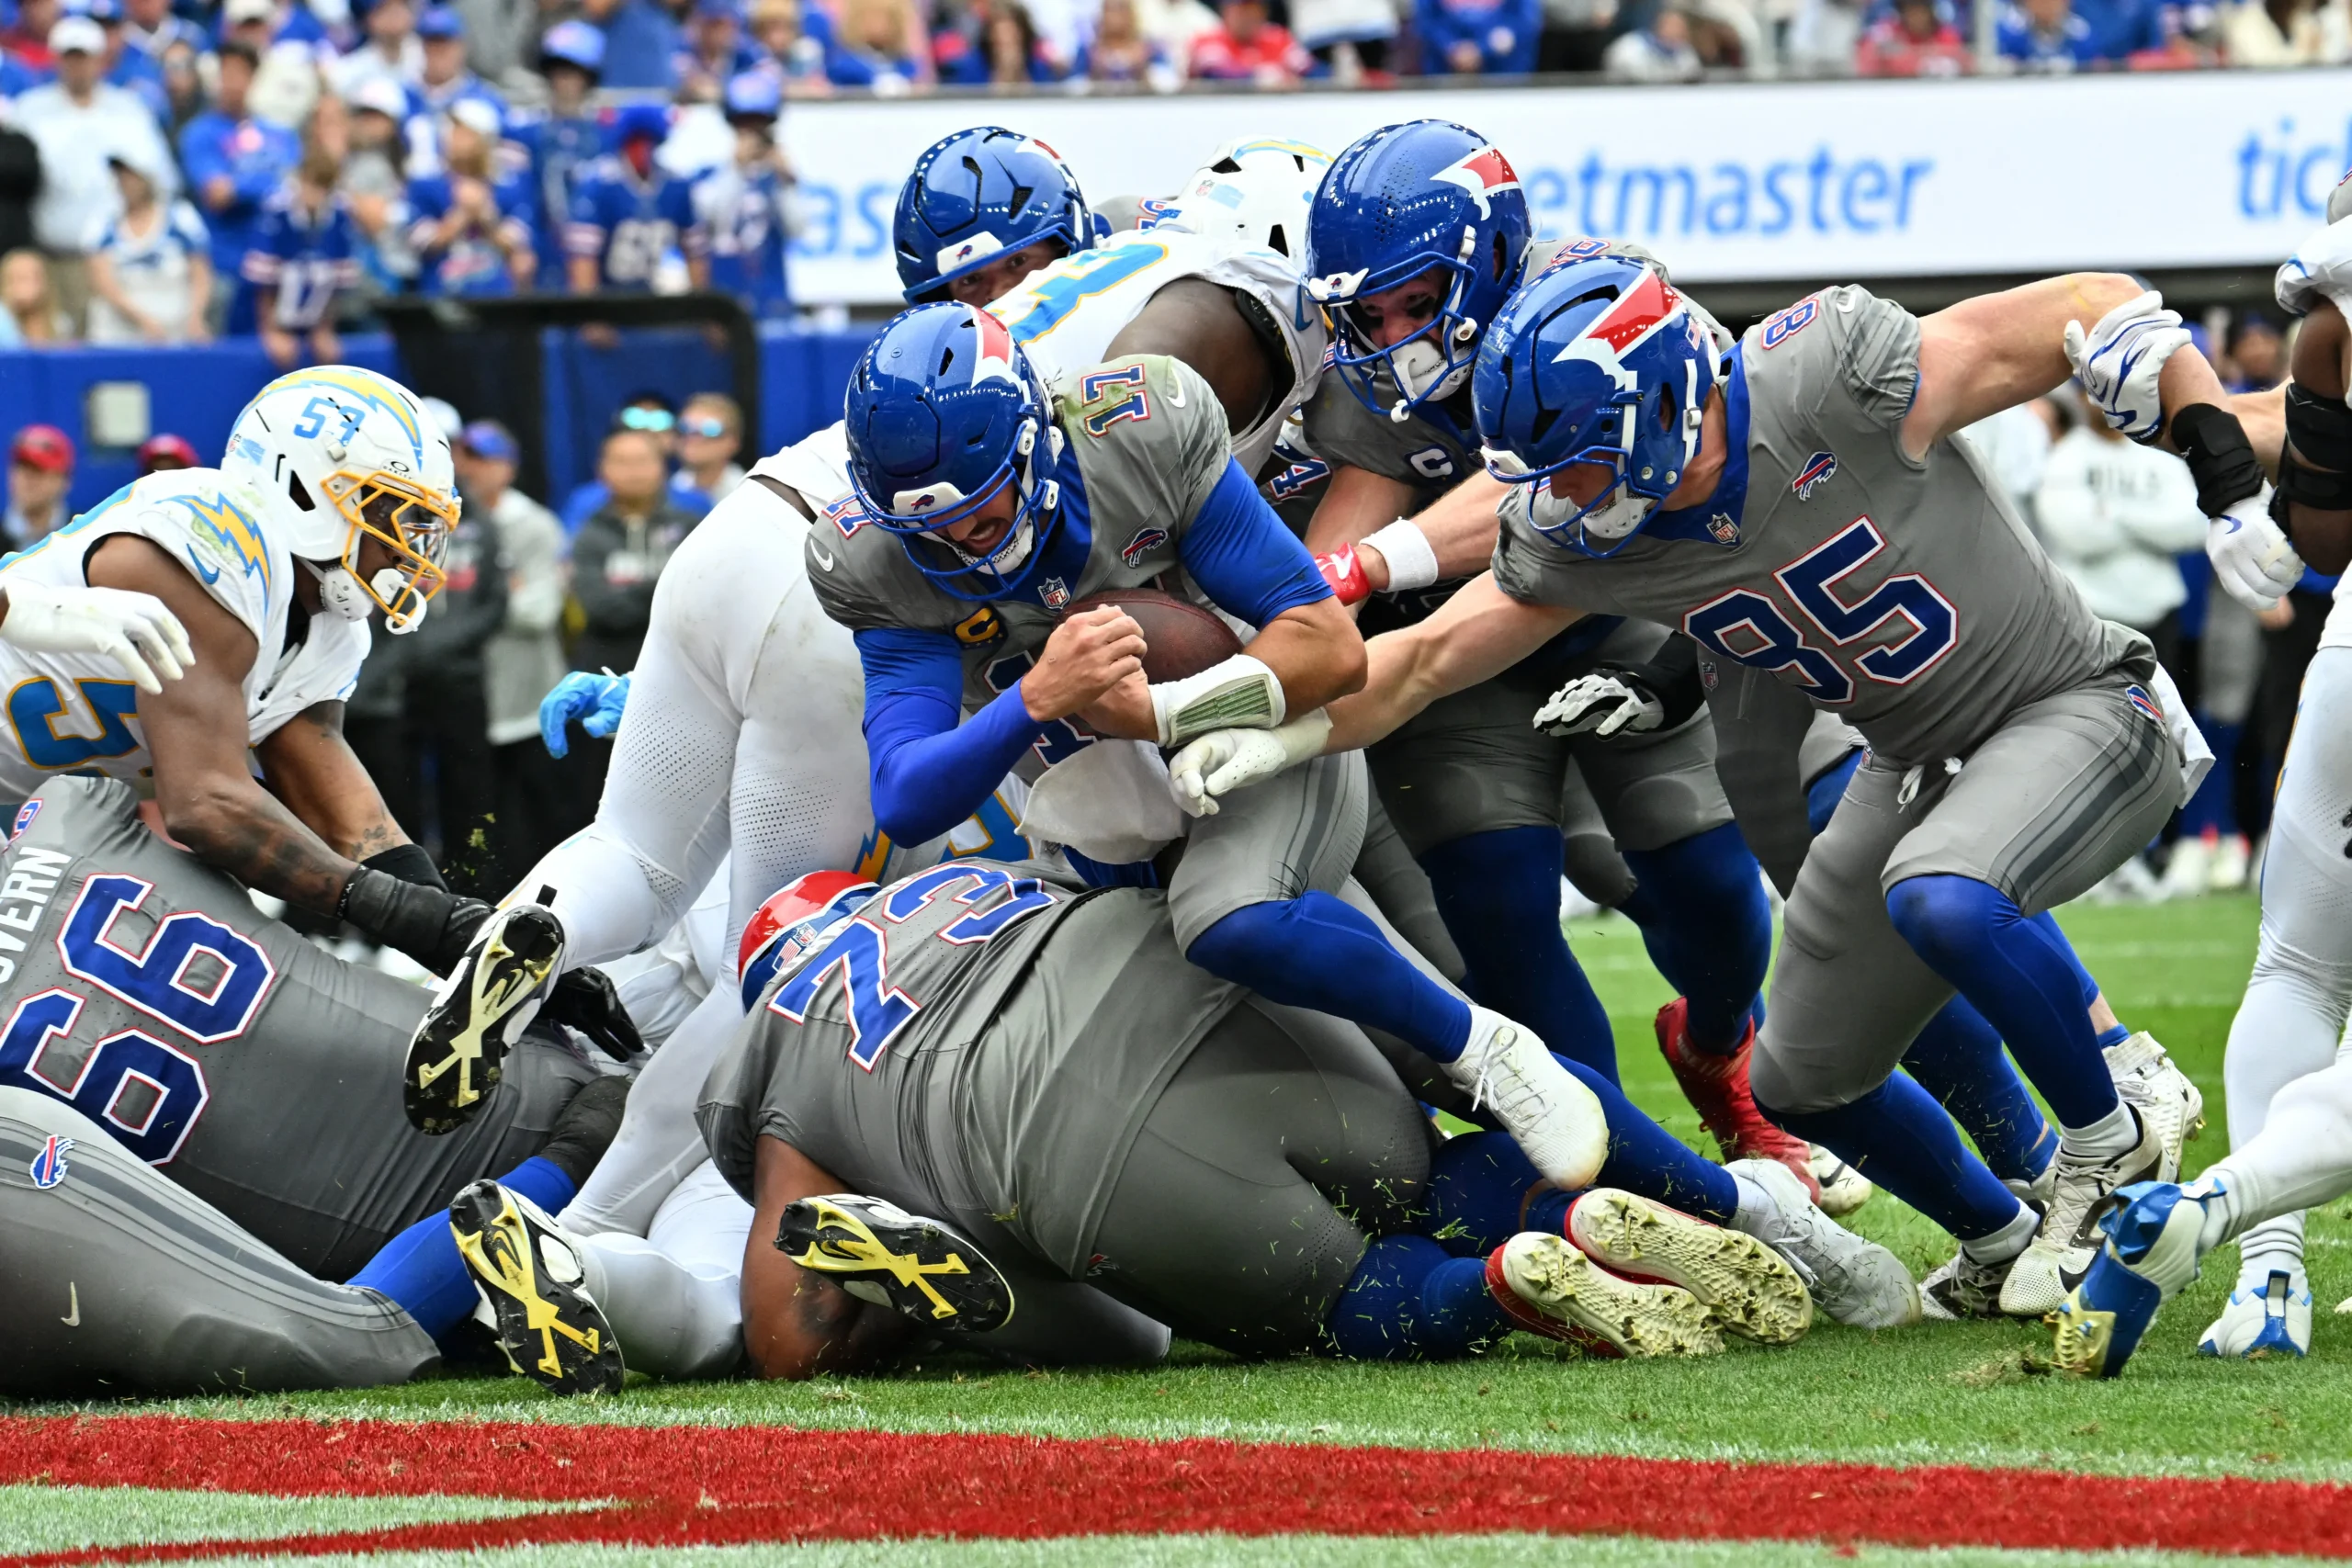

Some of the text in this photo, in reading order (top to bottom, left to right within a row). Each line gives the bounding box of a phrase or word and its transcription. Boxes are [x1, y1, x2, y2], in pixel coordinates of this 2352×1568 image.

[788, 179, 899, 260] as
[1523, 142, 1933, 239] etmaster
[1761, 286, 1834, 350] 8
[1080, 363, 1151, 438] 17
[1410, 448, 1453, 479] C
[1715, 525, 1736, 540] NFL
[955, 607, 1000, 643] C
[1046, 589, 1068, 606] NFL
[1682, 514, 1959, 704] 85
[767, 861, 1059, 1074] 73
[0, 873, 277, 1167] 66
